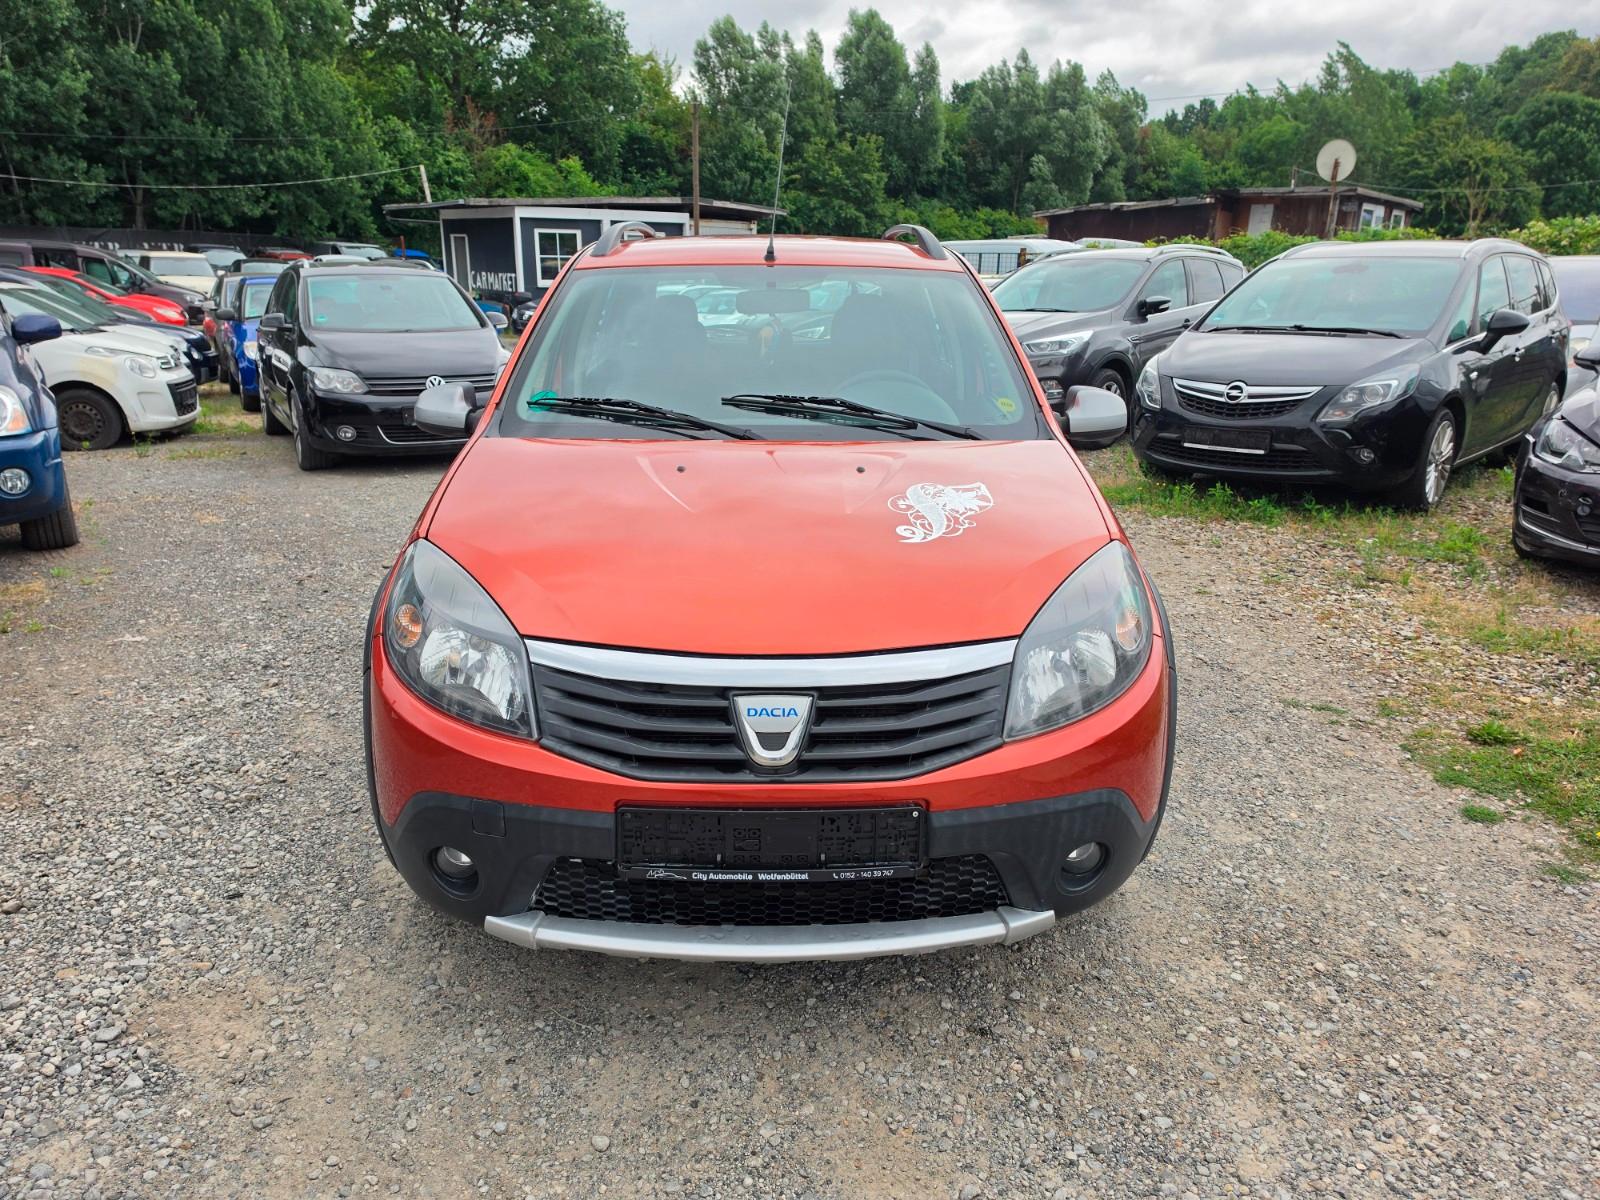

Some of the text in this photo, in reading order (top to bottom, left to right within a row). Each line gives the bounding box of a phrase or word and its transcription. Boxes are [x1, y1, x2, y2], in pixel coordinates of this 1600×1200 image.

[746, 707, 799, 718] DACIA
[691, 872, 708, 881] City
[708, 872, 753, 880] Automobile
[757, 872, 809, 881] Wolfenbüttel
